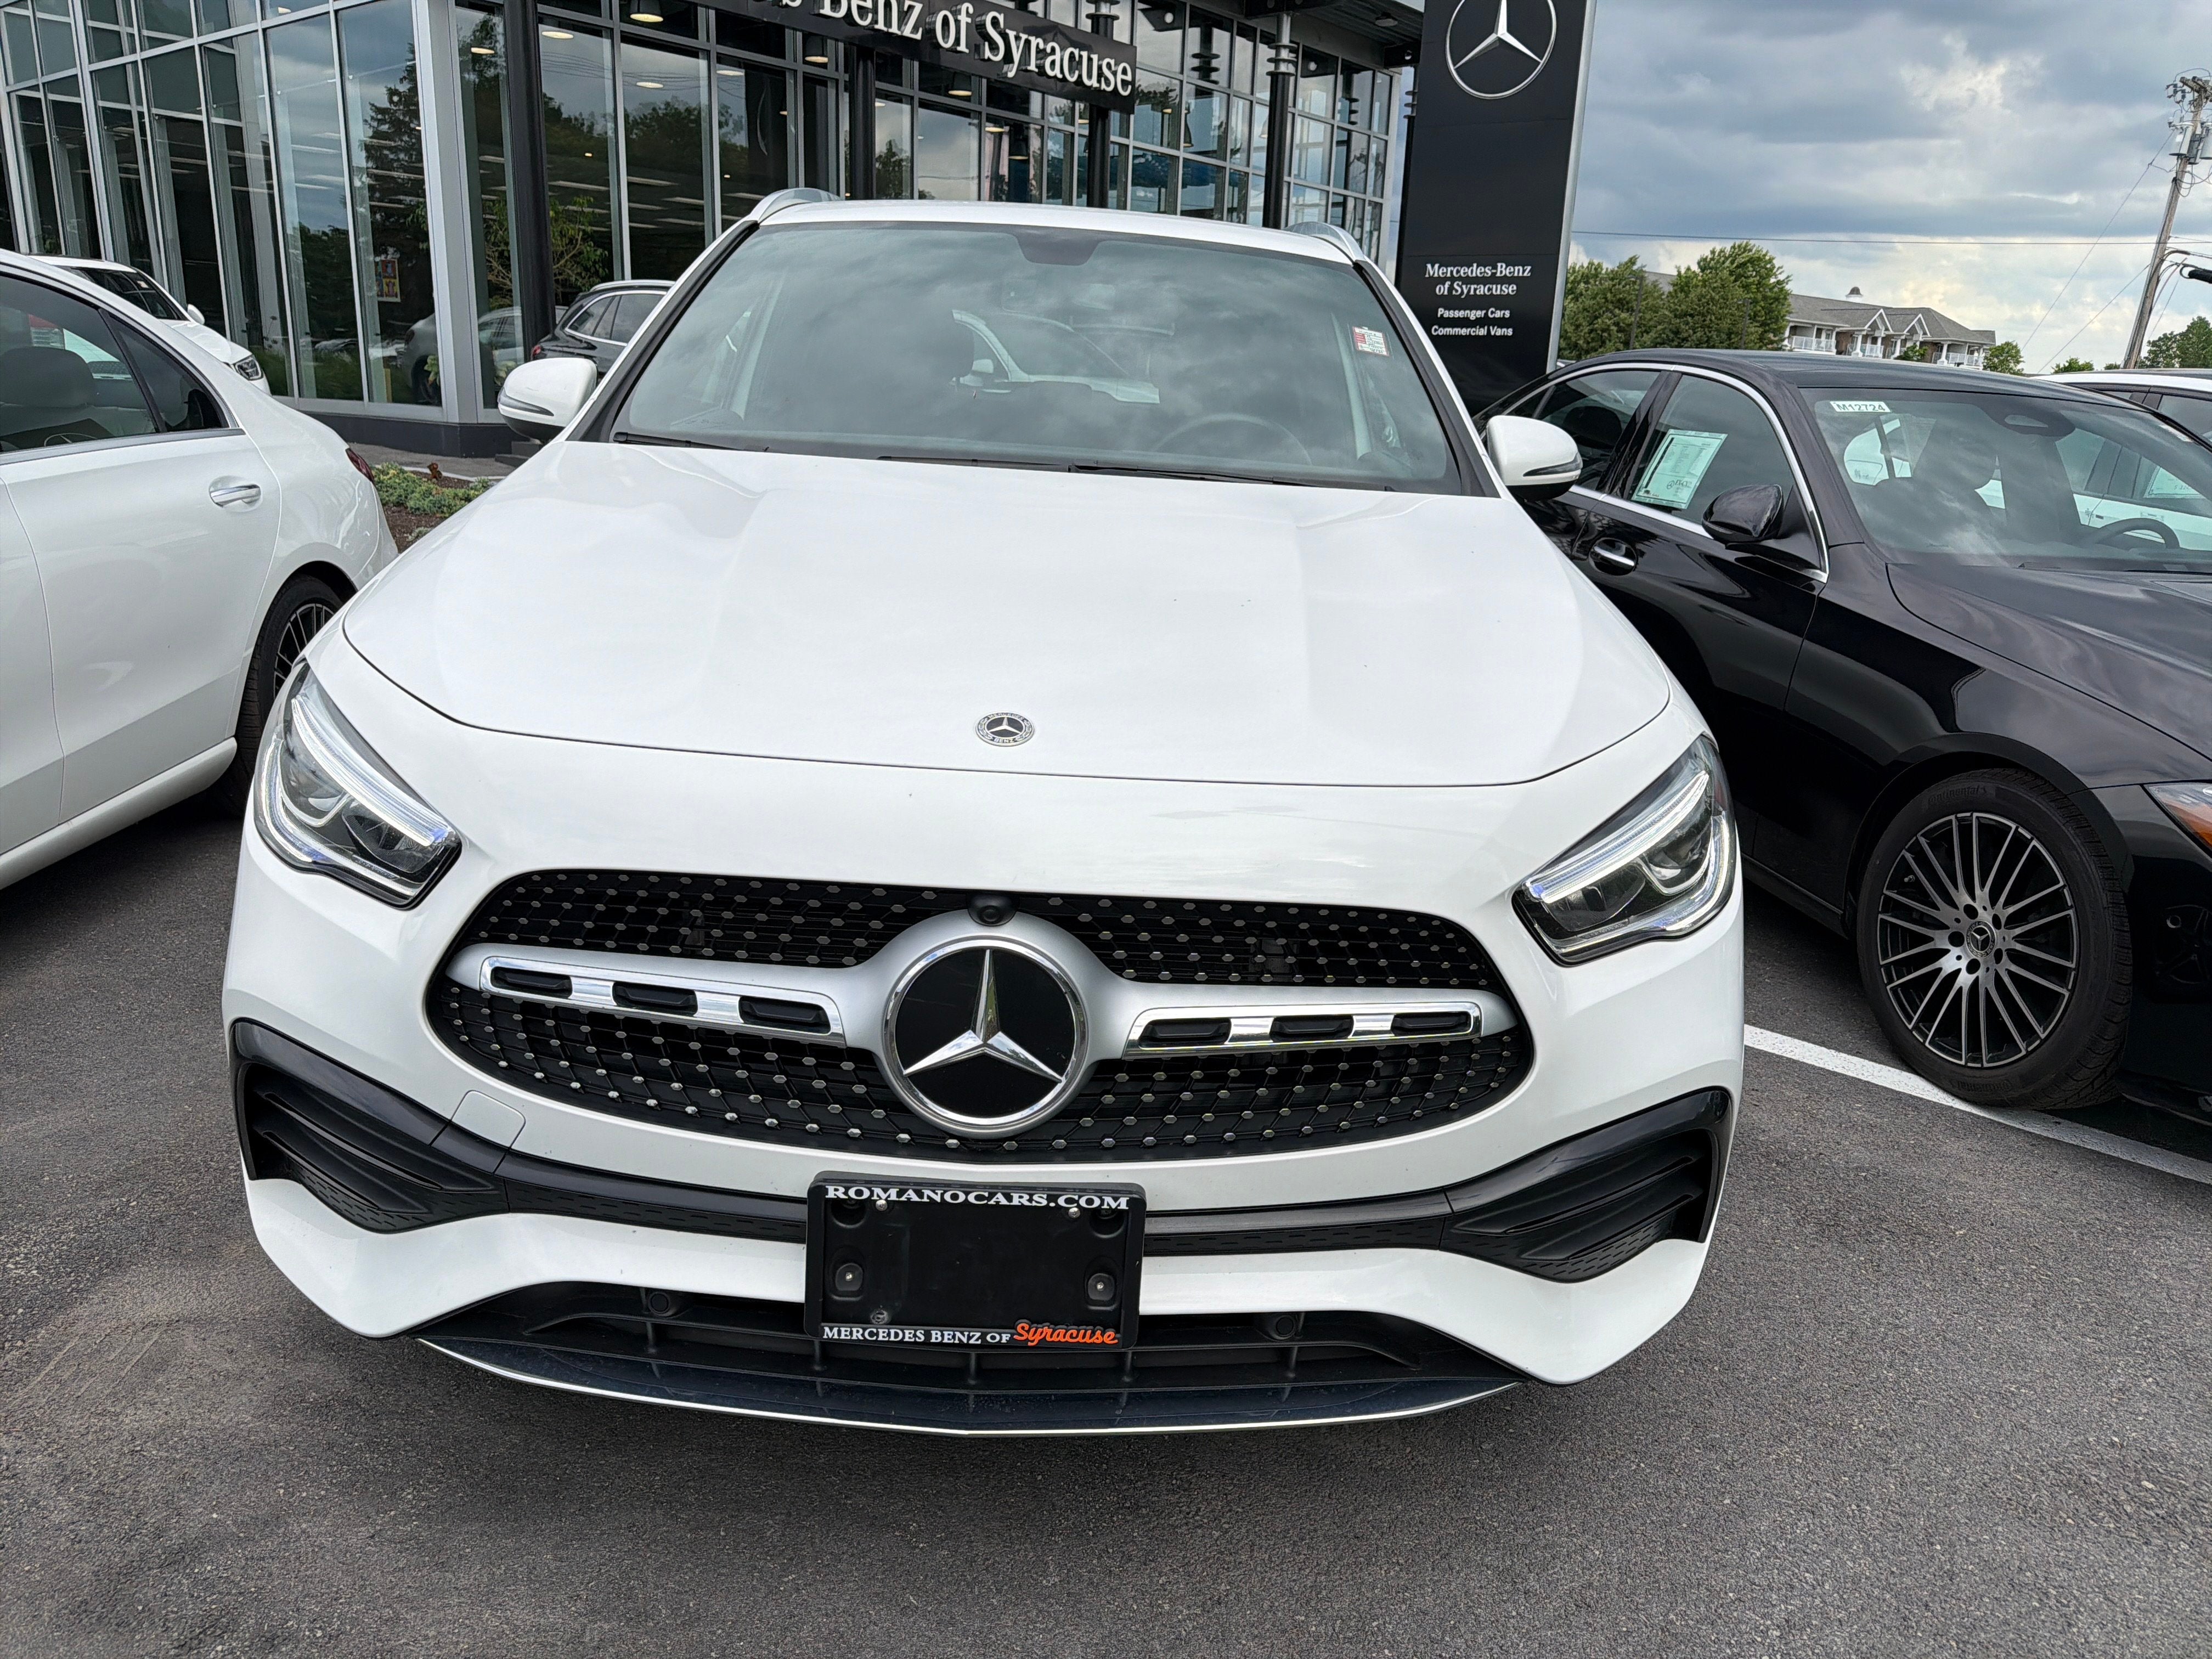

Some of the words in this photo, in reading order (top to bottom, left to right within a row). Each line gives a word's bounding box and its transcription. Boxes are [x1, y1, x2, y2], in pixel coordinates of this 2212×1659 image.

[935, 2, 974, 53] of
[984, 11, 1132, 96] Syracuse
[1425, 263, 1531, 277] Mercedes-Benz
[1436, 281, 1451, 295] of
[1453, 281, 1517, 298] Syracuse
[1437, 308, 1486, 320] Passenger
[1488, 308, 1510, 318] Cars
[1431, 325, 1487, 336] Commercial
[1489, 326, 1513, 336] Vans
[825, 1186, 1129, 1209] ROMANOCARS.COM
[823, 1327, 925, 1342] MERCEDES
[931, 1330, 981, 1344] BENZ
[986, 1333, 1011, 1344] OF
[1013, 1322, 1118, 1346] Syracuse
